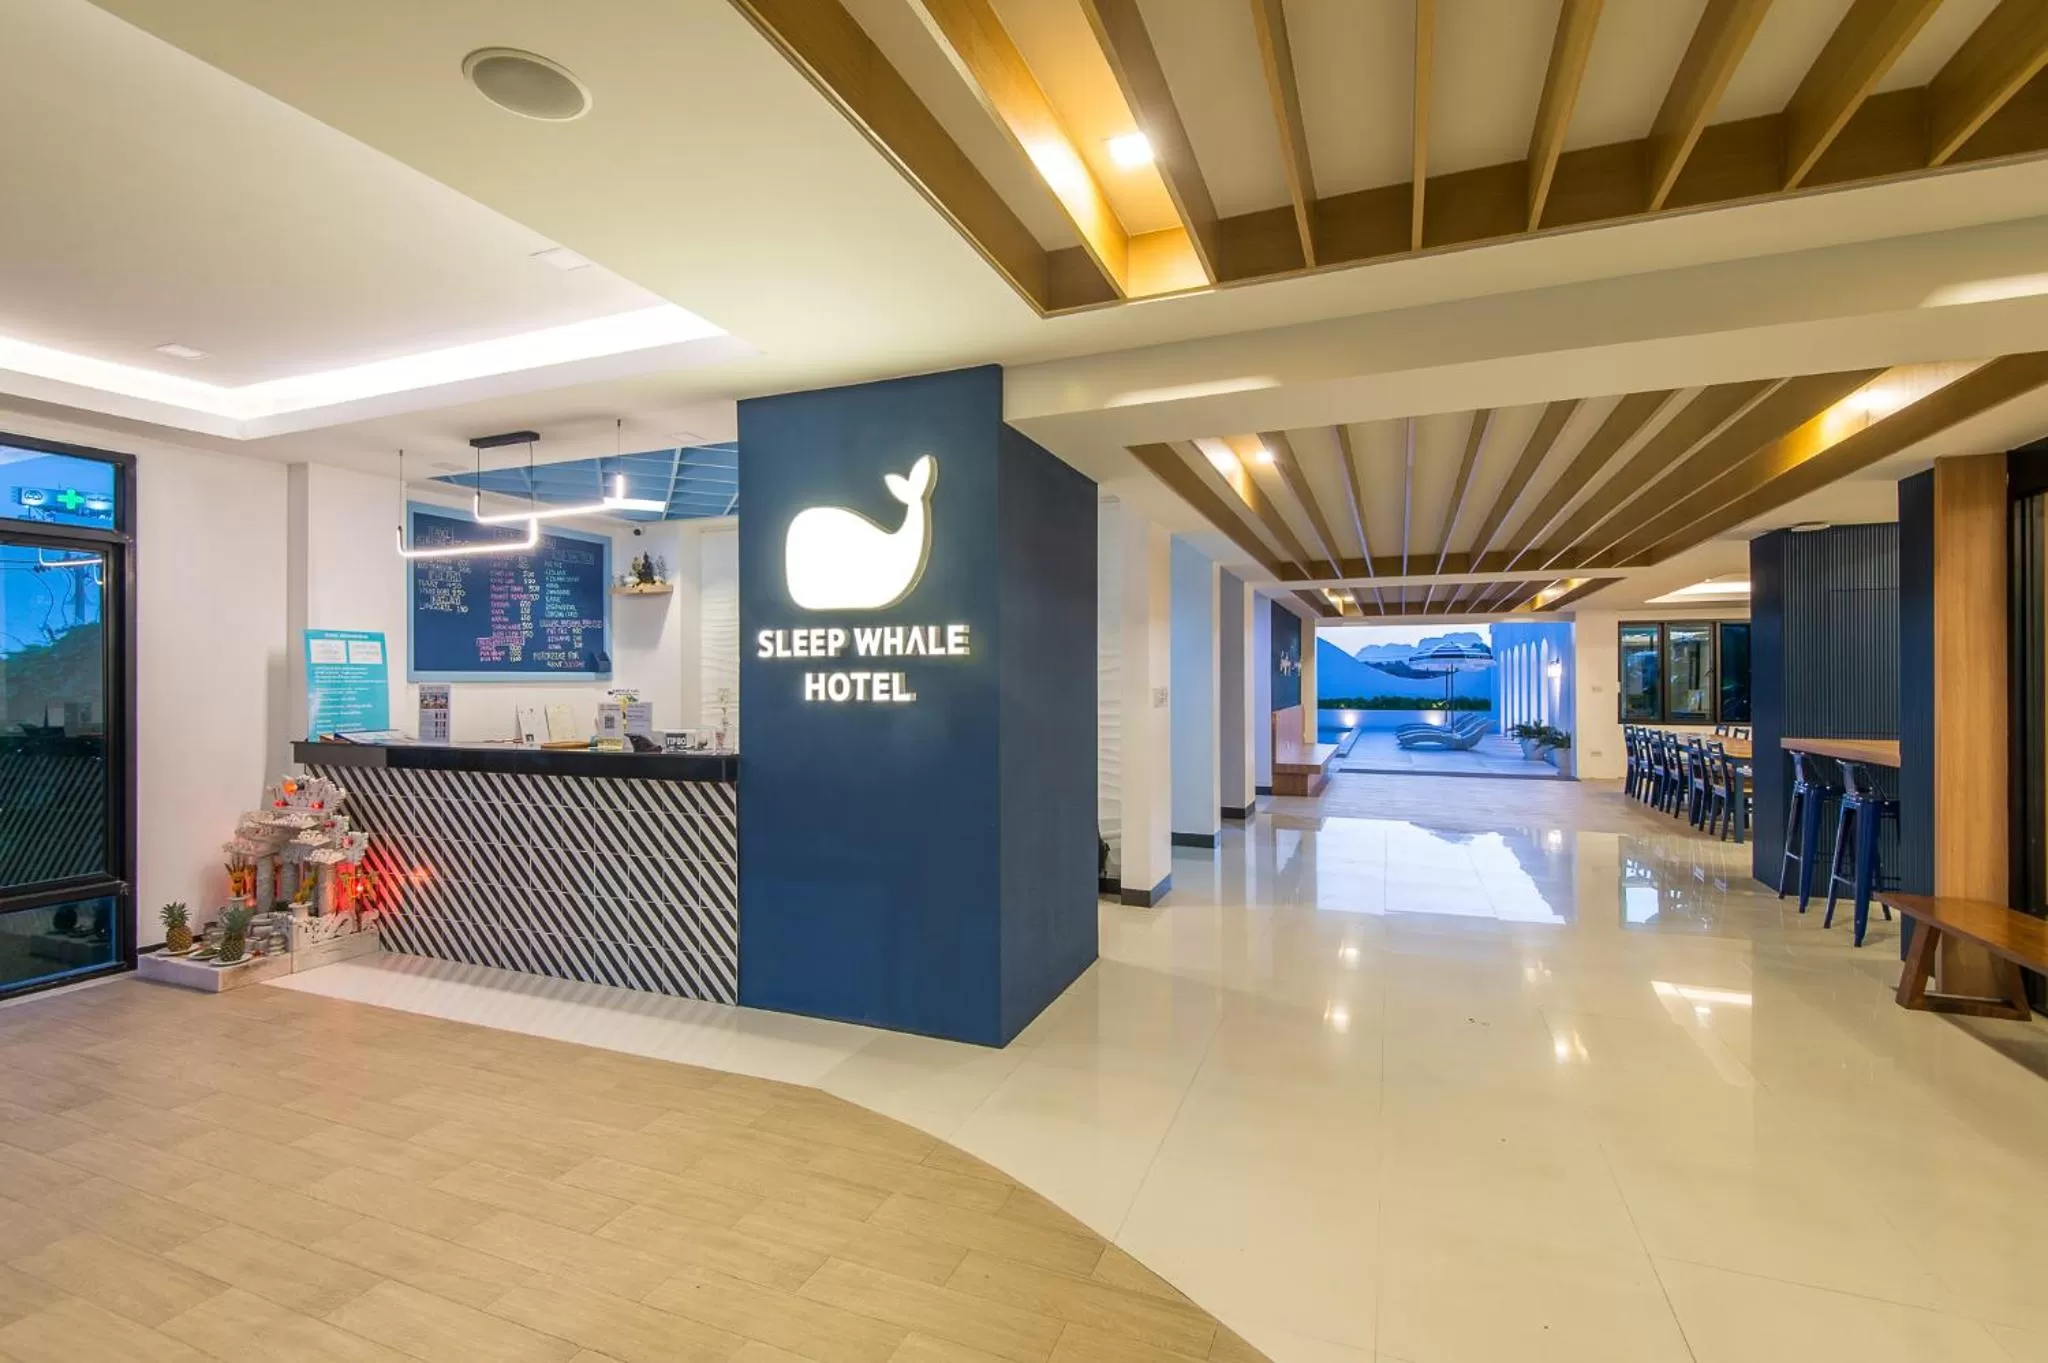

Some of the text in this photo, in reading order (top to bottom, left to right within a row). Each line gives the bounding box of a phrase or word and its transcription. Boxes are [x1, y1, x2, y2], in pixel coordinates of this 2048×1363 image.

[757, 624, 970, 658] SLEEP WHALE
[805, 672, 917, 701] HOTEL
